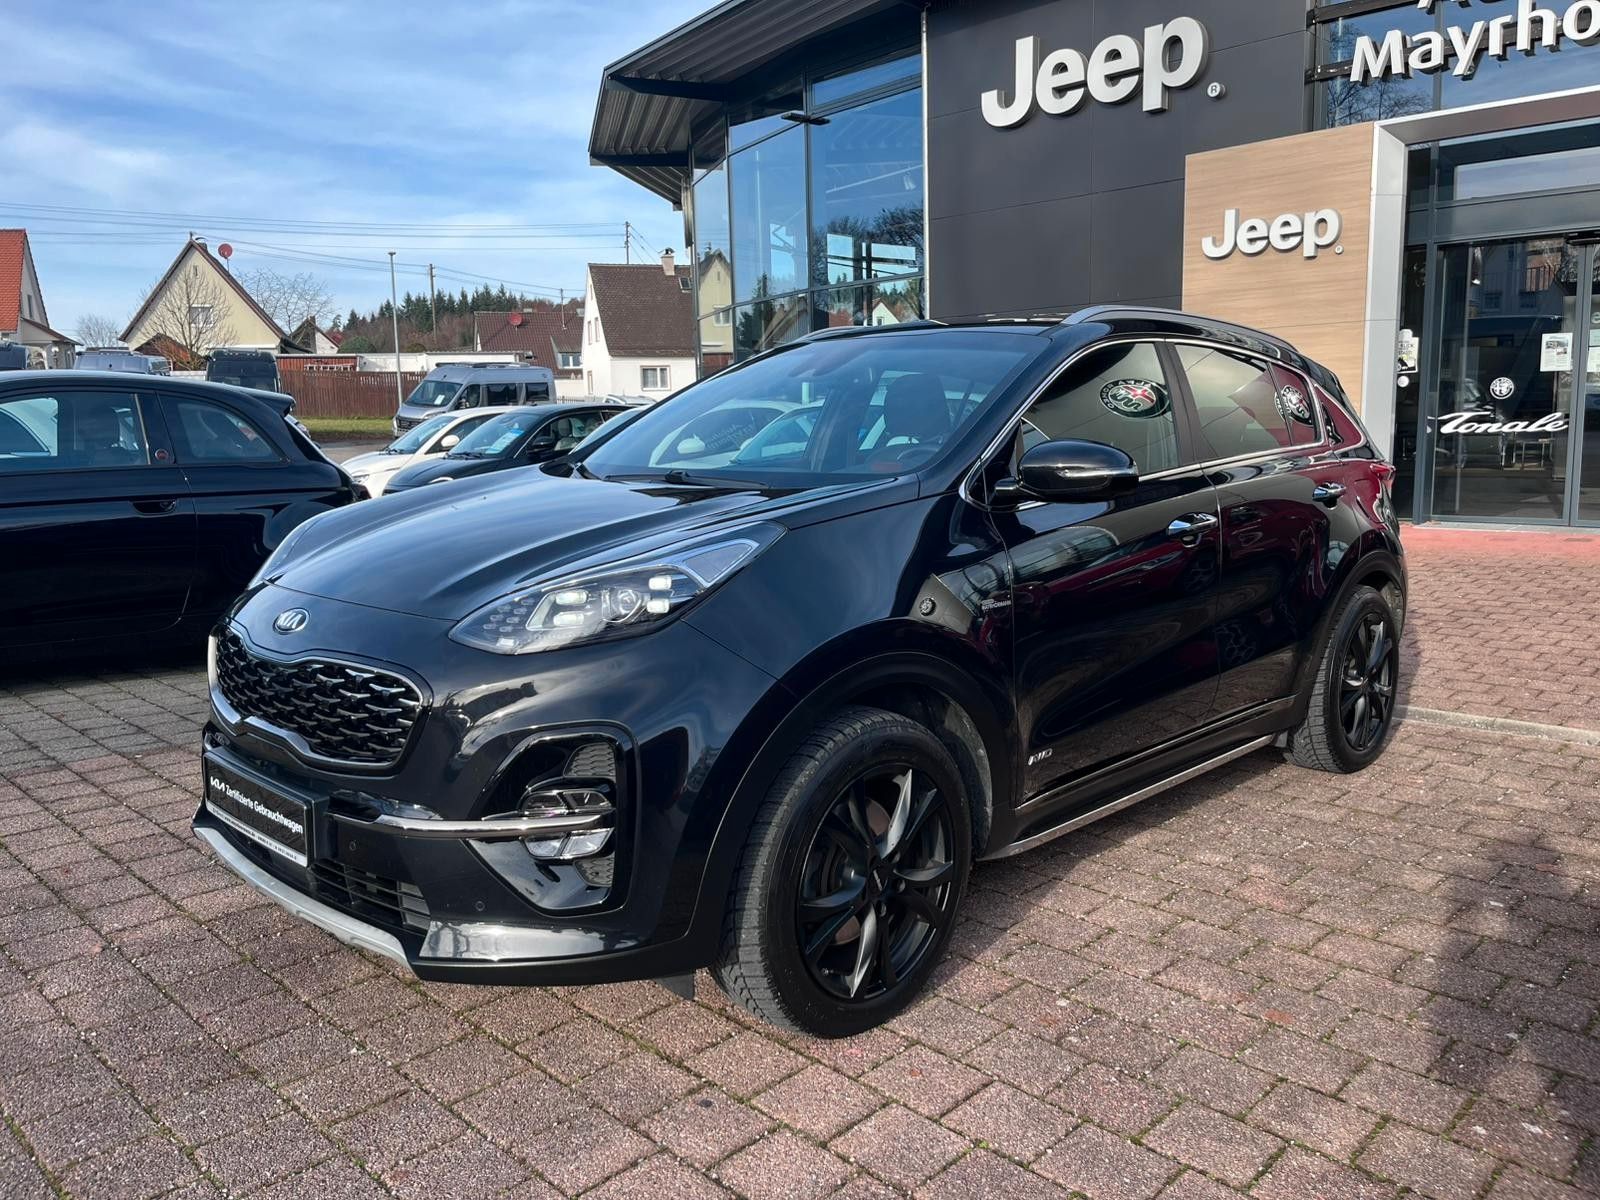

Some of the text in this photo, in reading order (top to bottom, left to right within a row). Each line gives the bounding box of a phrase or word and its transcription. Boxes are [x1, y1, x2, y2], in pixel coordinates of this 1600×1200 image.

[981, 16, 1207, 127] Jeep
[1201, 207, 1341, 259] Jeep
[1438, 411, 1568, 434] Tonale
[254, 800, 304, 834] Gebrauchtwagen
